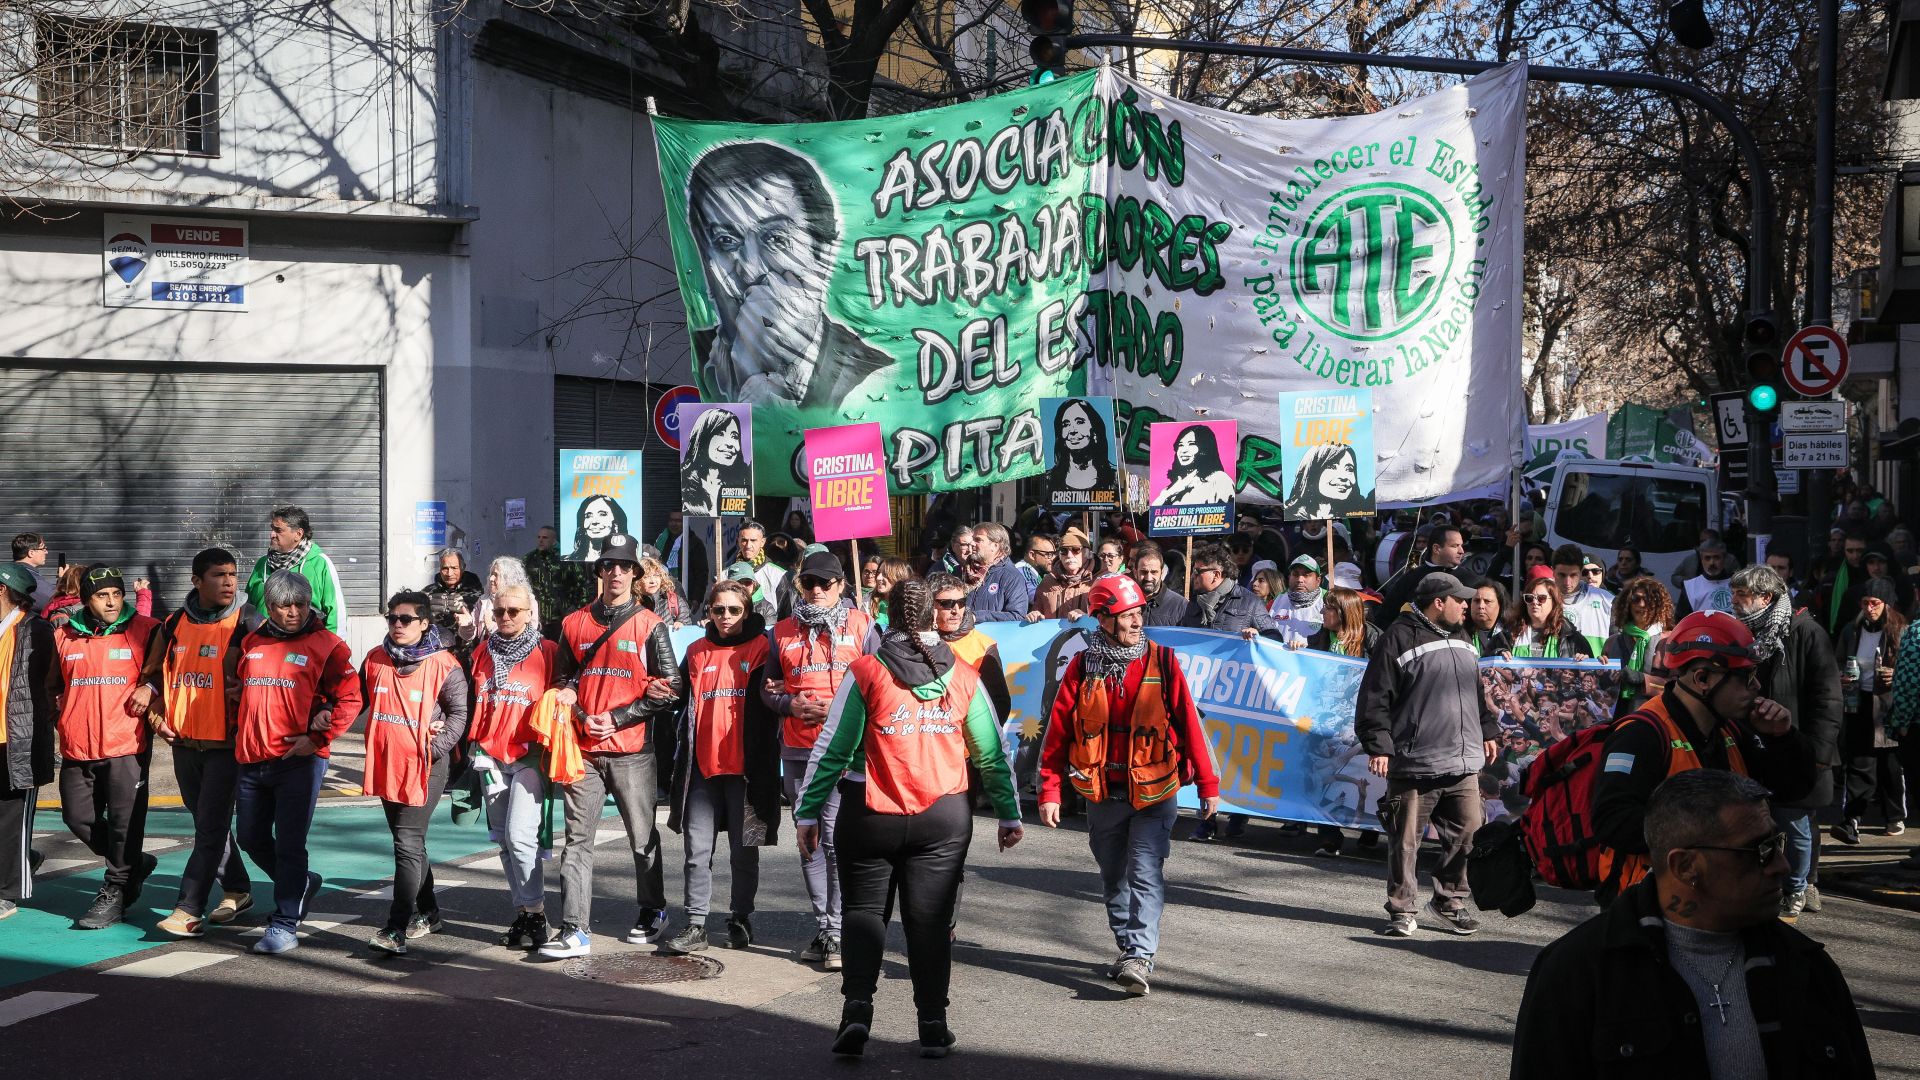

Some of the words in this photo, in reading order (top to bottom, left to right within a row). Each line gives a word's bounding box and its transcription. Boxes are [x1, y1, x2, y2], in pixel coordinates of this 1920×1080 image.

[1253, 141, 1380, 253] Fortalecer
[1389, 135, 1417, 166] el
[1426, 138, 1494, 234] Estado
[175, 229, 220, 242] VENDE
[111, 245, 144, 256] RE/MAX
[155, 249, 206, 260] GUILLERMO
[208, 252, 240, 261] FRIMET
[855, 192, 1233, 307] TRABAJADORES
[169, 260, 227, 270] 15.5050.2273
[1302, 193, 1440, 331] ATE
[169, 283, 198, 292] RE/MAX
[199, 284, 227, 293] ENERGY
[166, 291, 231, 303] 4308-1212
[1244, 273, 1298, 350] para
[1293, 331, 1395, 387] liberar
[1397, 343, 1429, 378] la
[1419, 256, 1487, 363] Nación
[912, 312, 1022, 405] DEL
[1036, 289, 1184, 387] ESTADO
[1802, 340, 1832, 381] E
[1294, 395, 1357, 414] CRISTINA
[1293, 418, 1355, 447] LIBRE
[1788, 441, 1808, 450] Días
[1810, 440, 1842, 449] hábiles
[573, 455, 628, 471] CRISTINA
[813, 452, 874, 475] CRISTINA
[1788, 453, 1799, 461] de
[1816, 452, 1826, 460] 21
[571, 475, 626, 498] LIBRE
[721, 487, 748, 496] CRISTINA
[815, 476, 874, 509] LIBRE
[1051, 490, 1090, 503] CRISTINA
[1090, 490, 1115, 503] LIBRE
[721, 498, 747, 511] LIBRE
[1154, 508, 1161, 516] EL
[1162, 507, 1179, 516] AMOR
[1179, 507, 1187, 515] NO
[1195, 505, 1226, 514] PROSCRIBE
[1153, 514, 1198, 528] CRISTINA
[1198, 513, 1226, 526] LIBRE
[791, 662, 849, 677] ORGANIZACIO
[701, 688, 746, 701] ORANIZACI
[372, 711, 419, 729] RGANIACIO
[890, 704, 912, 723] La
[916, 705, 953, 723] lealtad
[881, 725, 896, 735] no
[901, 723, 916, 736] se
[919, 723, 958, 736] negocia
[1205, 718, 1289, 799] BRE
